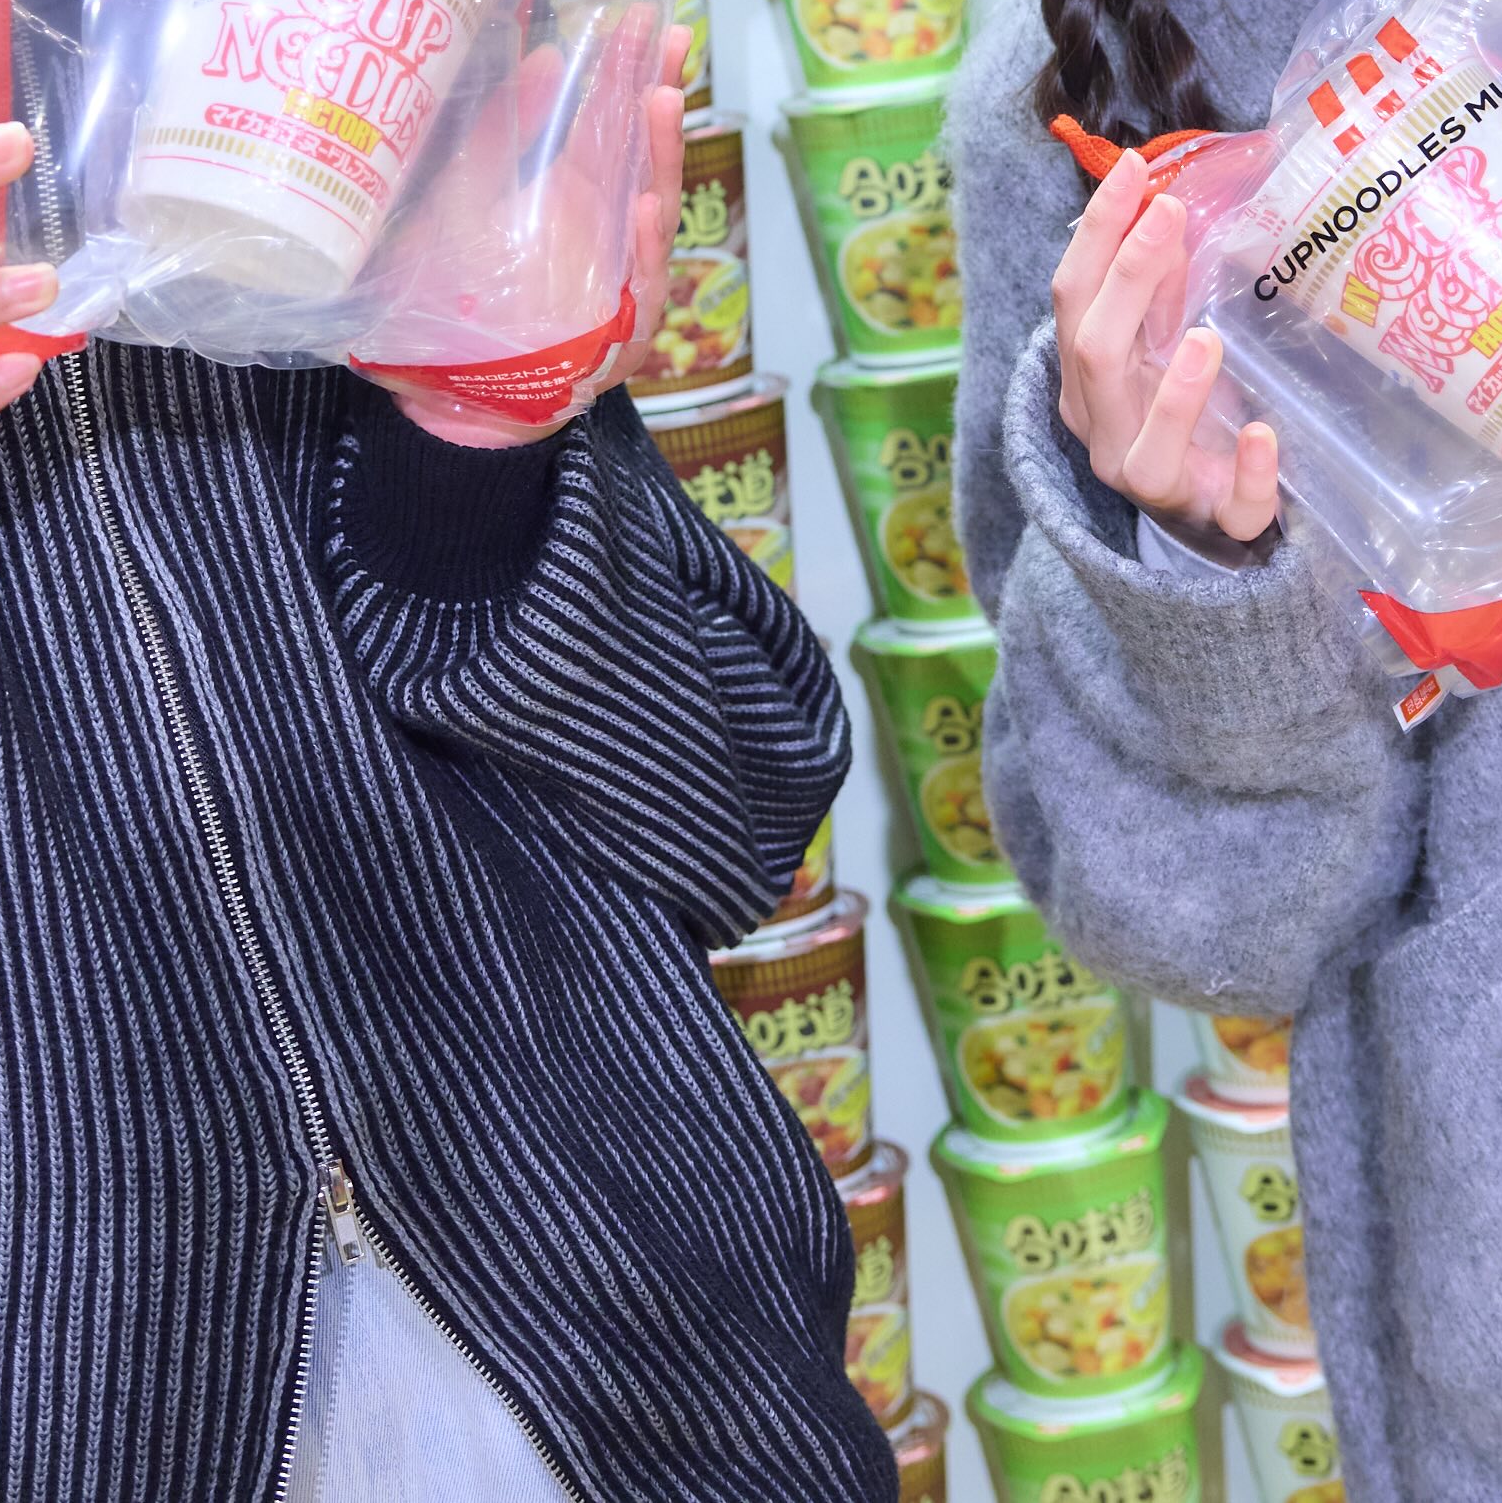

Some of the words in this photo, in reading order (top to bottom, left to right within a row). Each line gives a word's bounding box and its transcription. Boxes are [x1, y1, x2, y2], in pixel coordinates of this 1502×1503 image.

[282, 88, 383, 158] FACTORY
[1253, 116, 1466, 302] CUPNOODLES
[1339, 272, 1382, 327] MY
